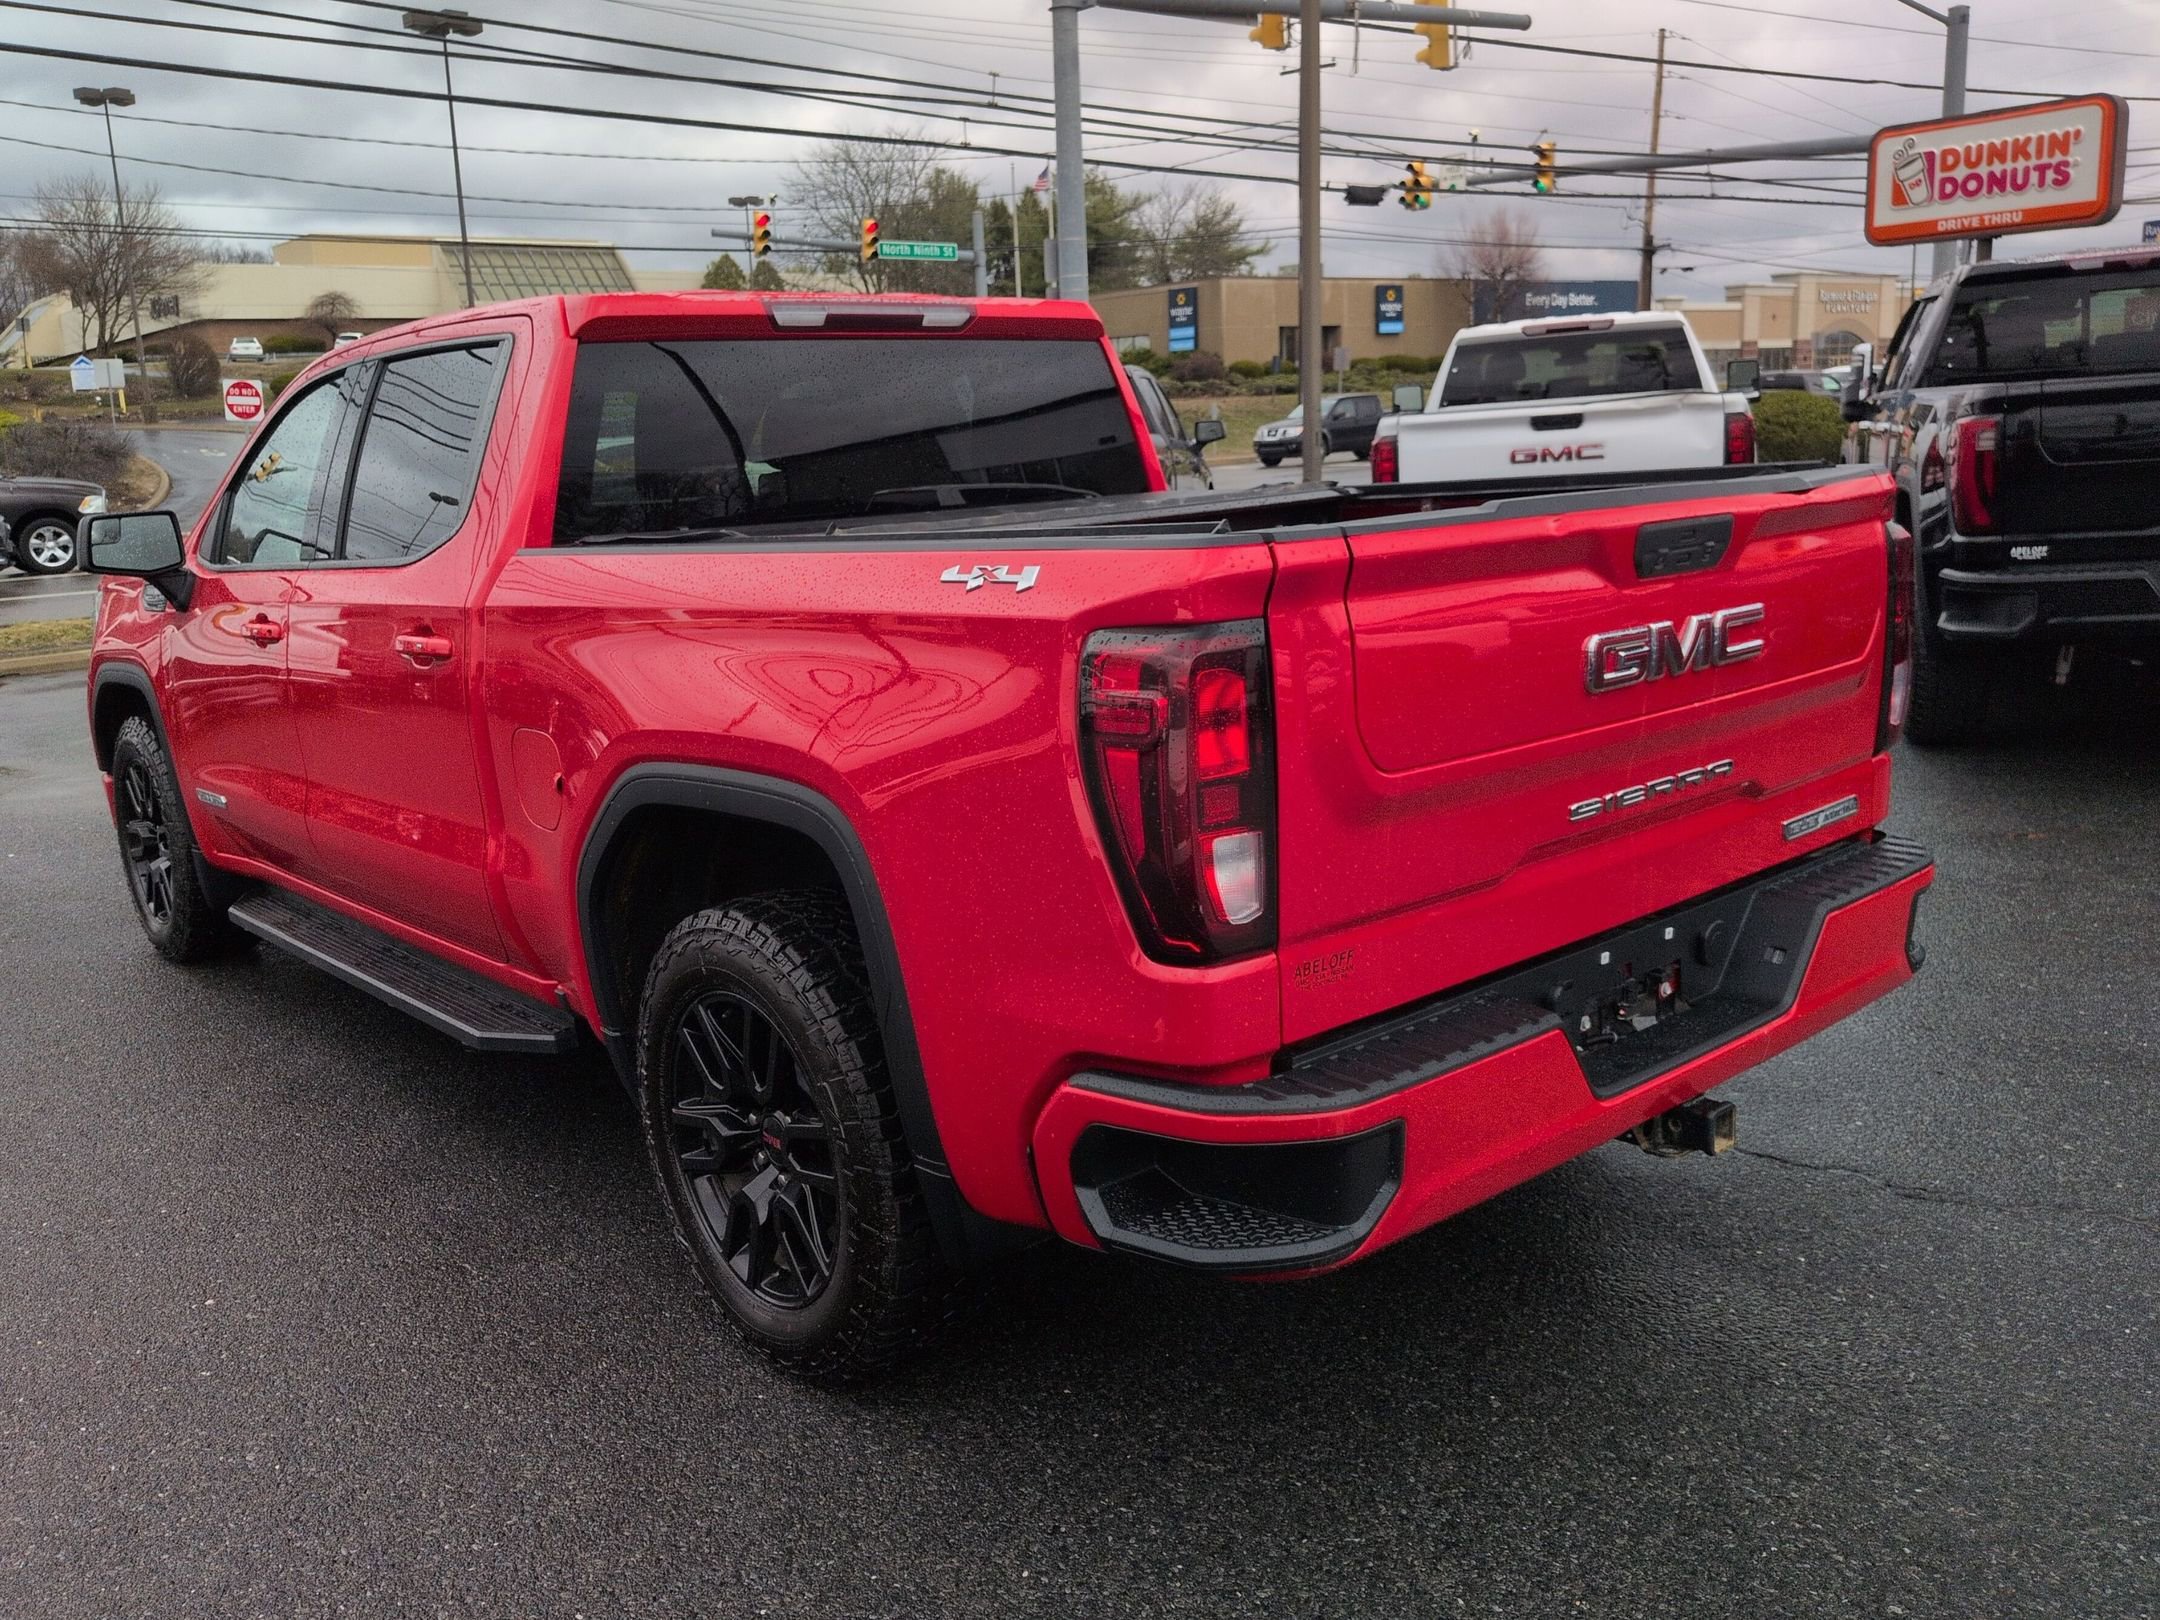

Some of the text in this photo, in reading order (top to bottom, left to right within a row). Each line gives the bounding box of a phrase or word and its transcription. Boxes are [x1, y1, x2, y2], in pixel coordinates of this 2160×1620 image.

[1939, 127, 2082, 173] DUNKIN'
[1938, 159, 2072, 201] DONUTS
[1937, 210, 2023, 232] DRIVE THRU
[882, 244, 954, 257] North Ninth St
[1525, 292, 1550, 309] Every
[1551, 293, 1568, 309] Day
[241, 388, 256, 396] NOT
[233, 406, 256, 414] ENTER
[1510, 443, 1605, 464] GMC
[1582, 602, 1765, 694] GMC
[1568, 758, 1734, 822] SIERRA
[1295, 949, 1354, 977] ABELOFF
